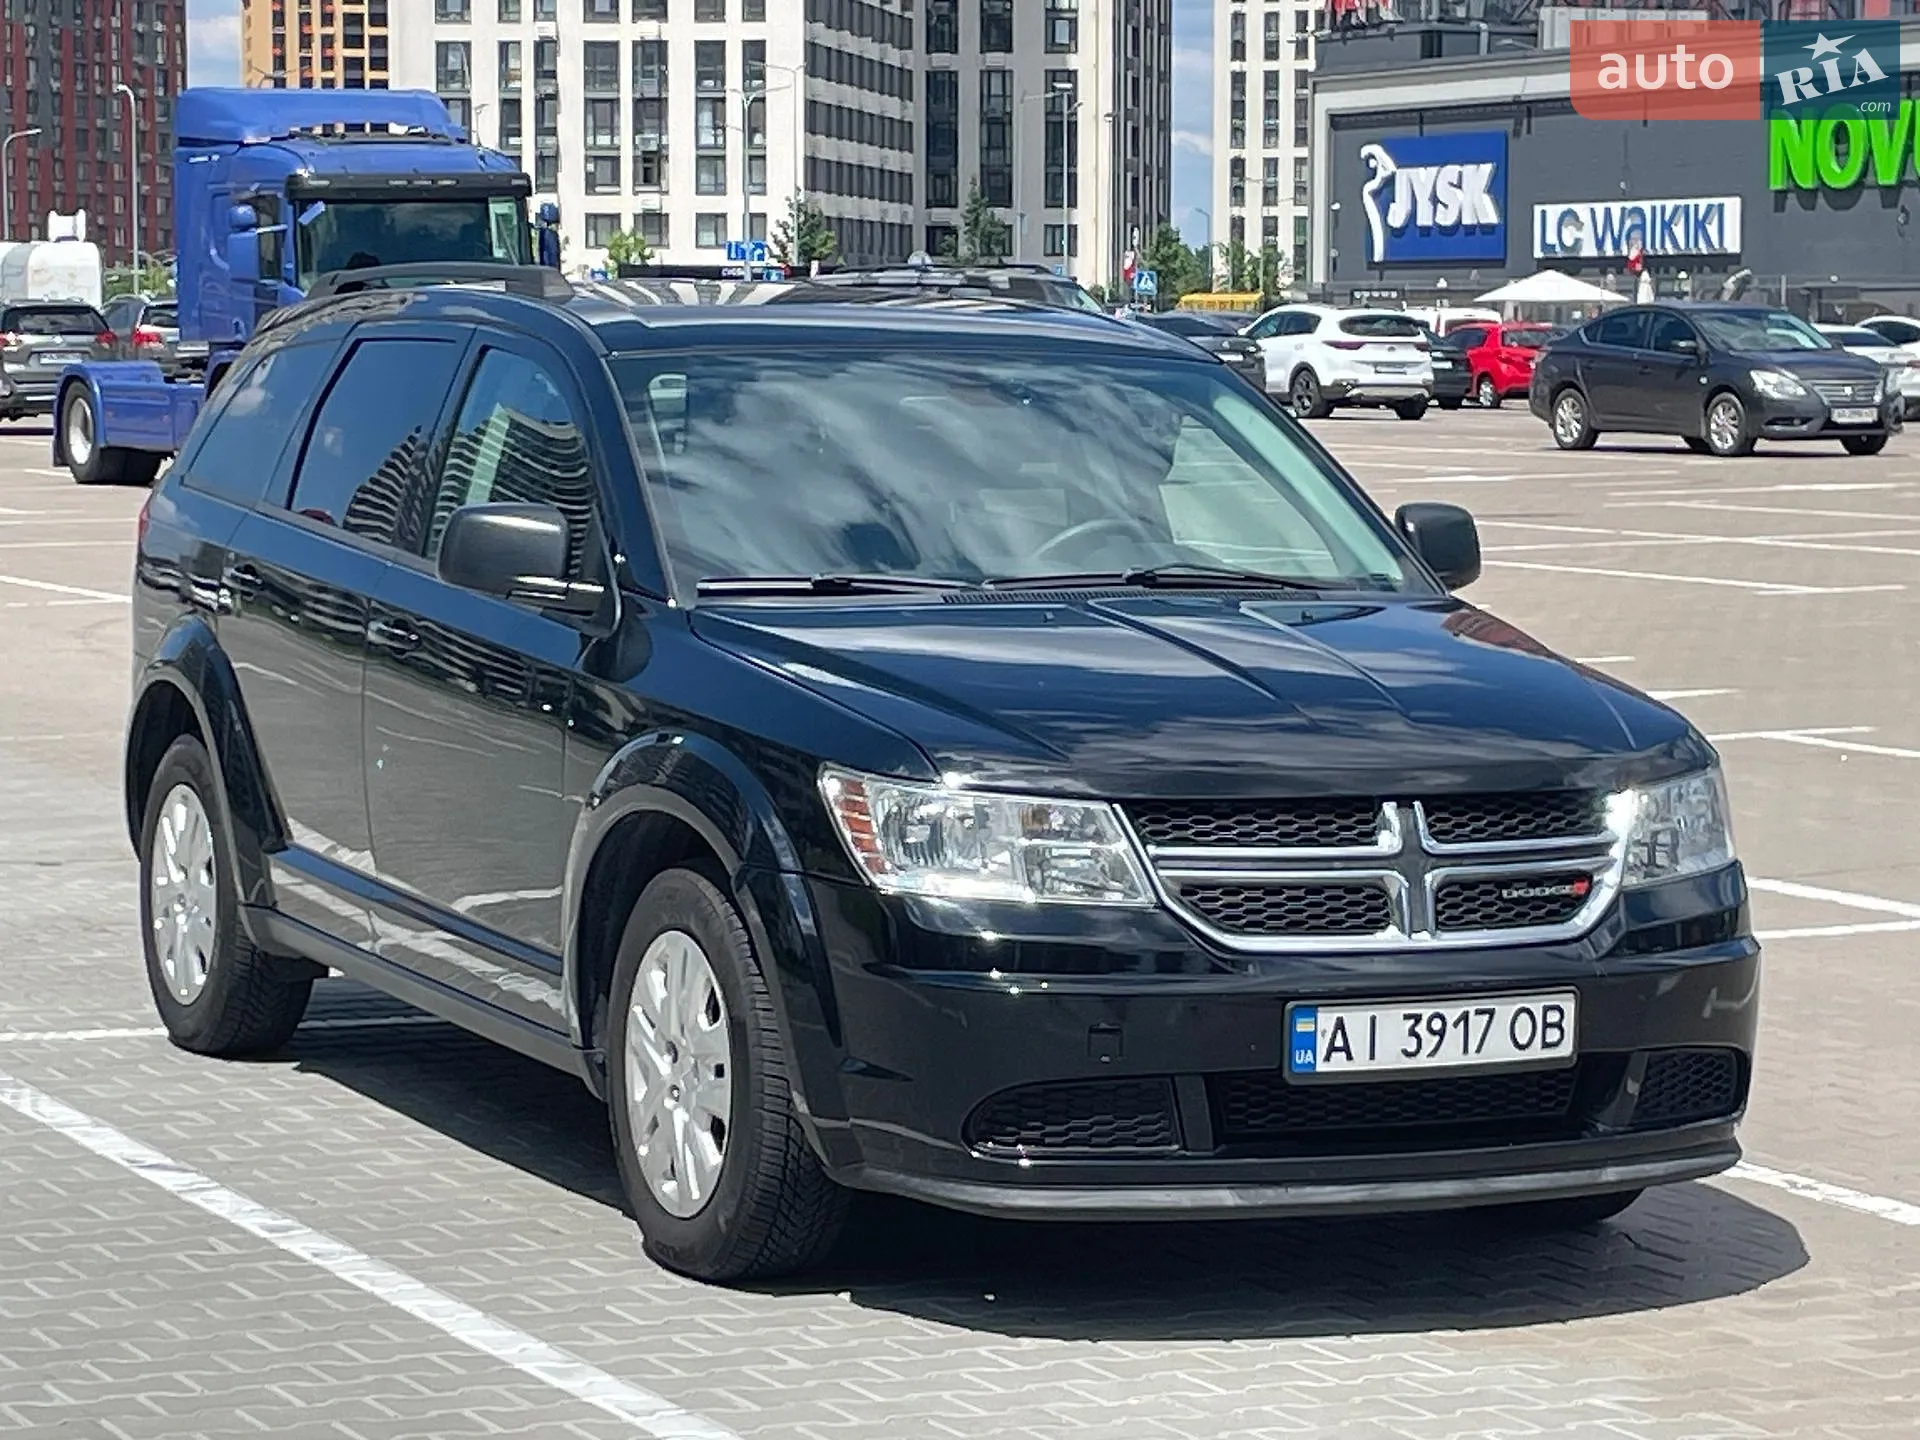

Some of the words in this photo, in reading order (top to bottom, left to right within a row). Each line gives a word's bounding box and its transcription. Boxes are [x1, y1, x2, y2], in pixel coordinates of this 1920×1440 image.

[1769, 99, 1920, 190] NOV
[1387, 161, 1499, 228] JYSK
[1540, 207, 1584, 254] LC
[1501, 884, 1575, 900] DODGE
[1401, 1007, 1496, 1058] 3917
[1509, 1004, 1566, 1051] OB
[1295, 1049, 1315, 1065] UA
